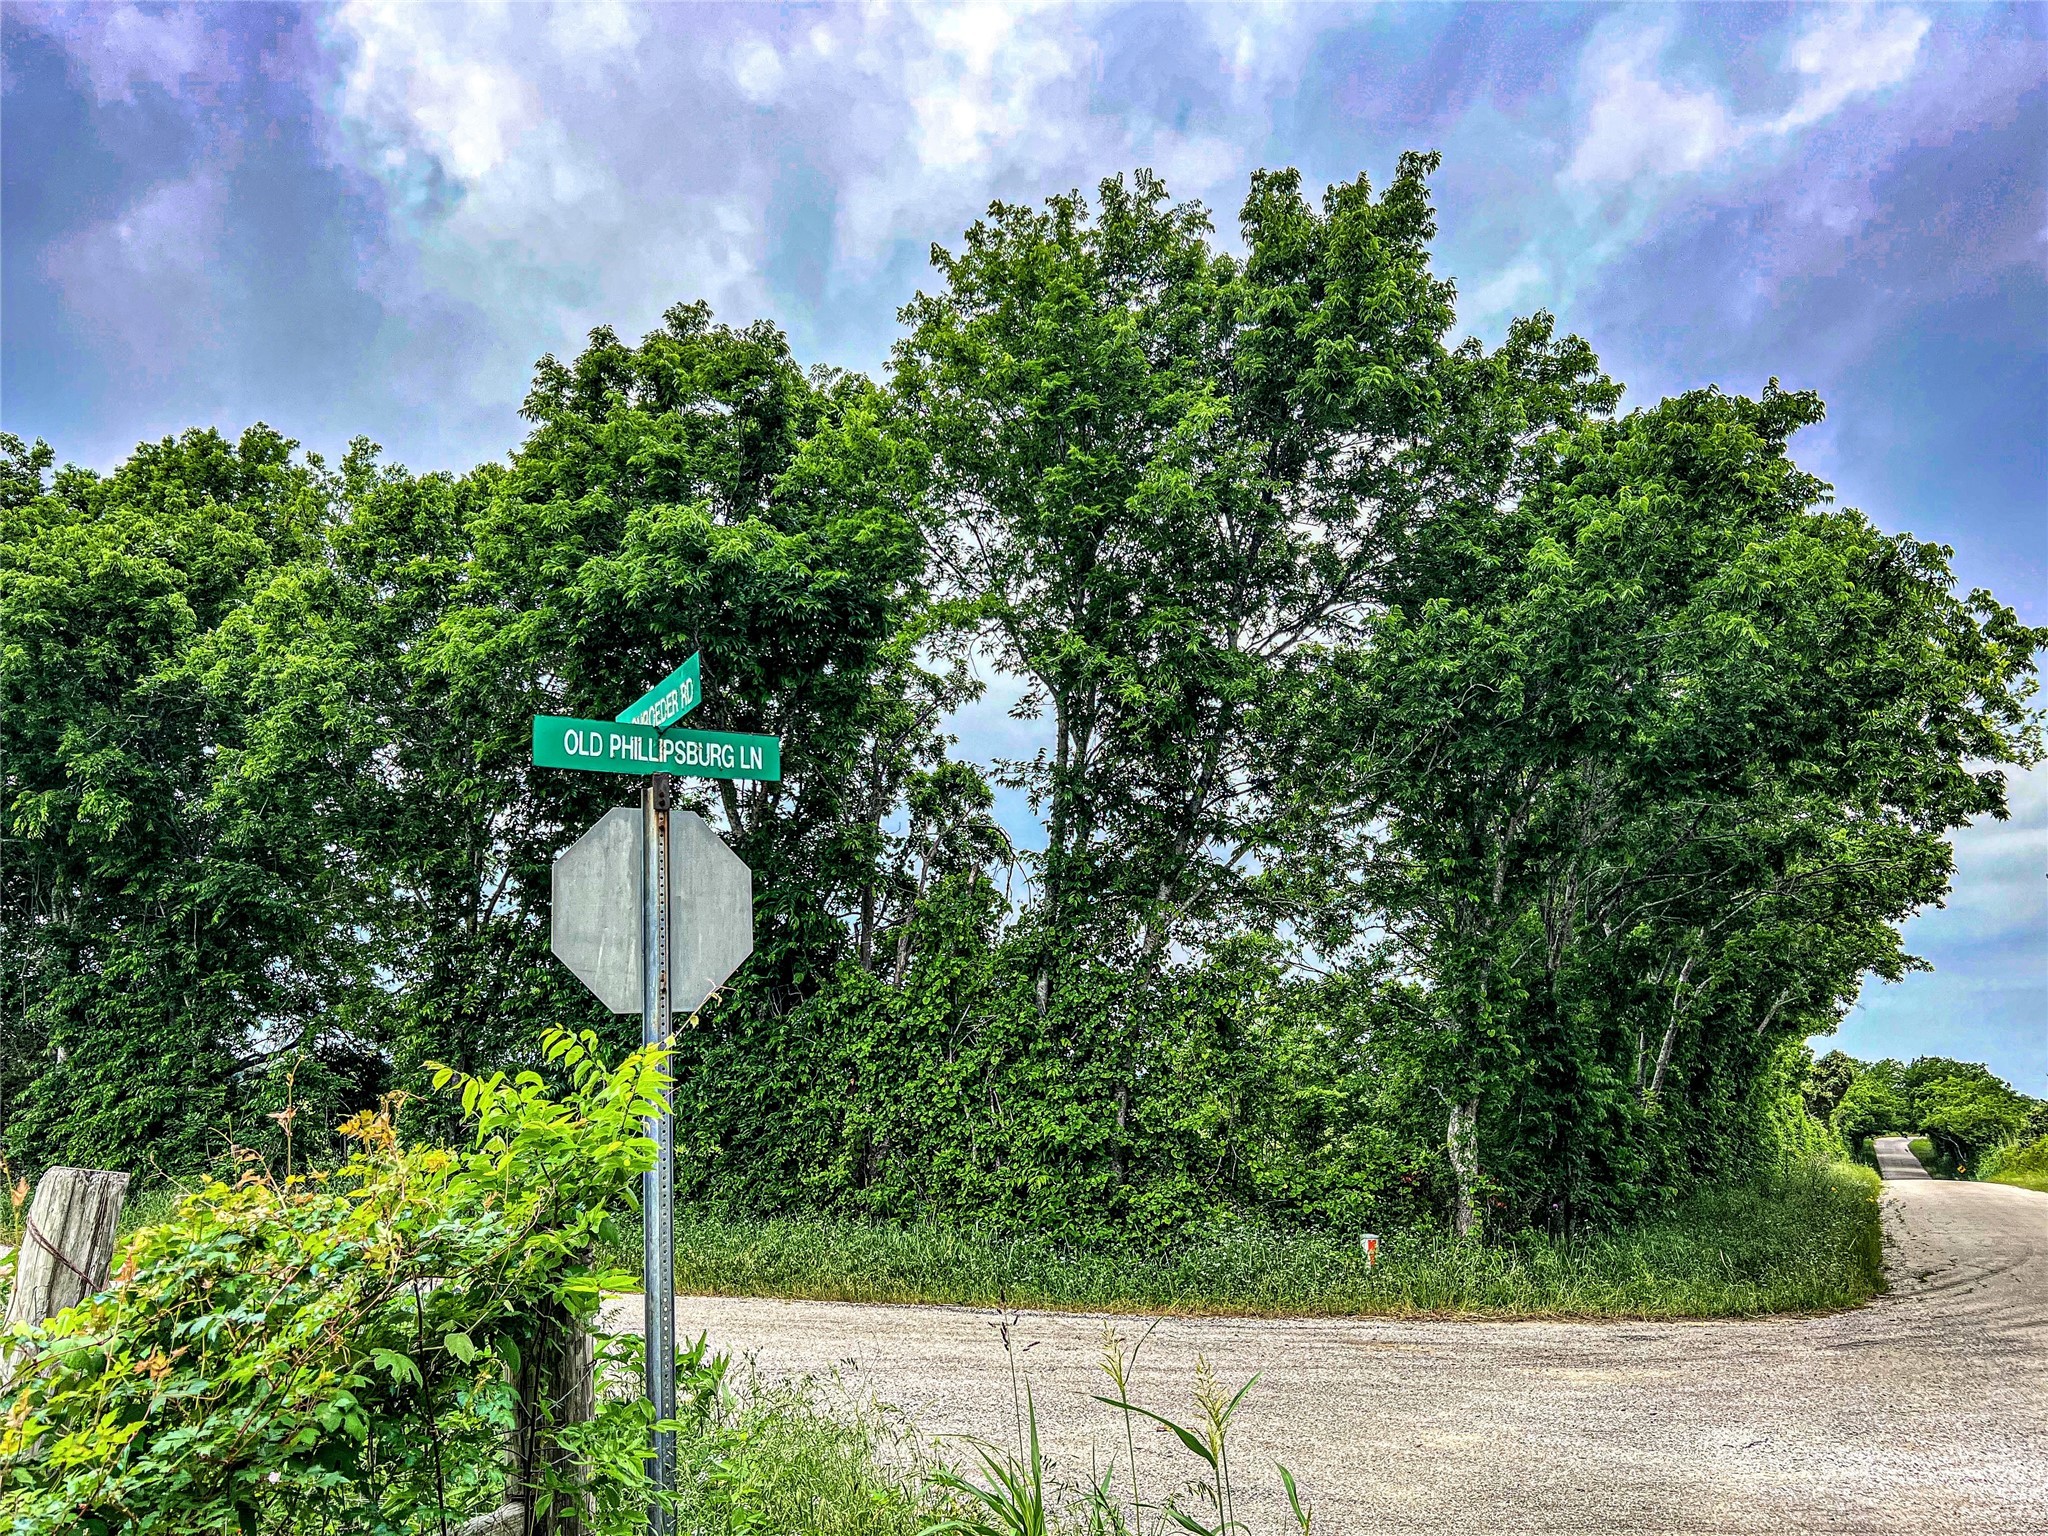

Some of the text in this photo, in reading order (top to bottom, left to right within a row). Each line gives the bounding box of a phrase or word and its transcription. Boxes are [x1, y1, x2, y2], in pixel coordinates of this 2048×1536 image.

[631, 677, 694, 727] ROEDER RD
[563, 728, 762, 770] OLD PHILLIPSBURG LN
